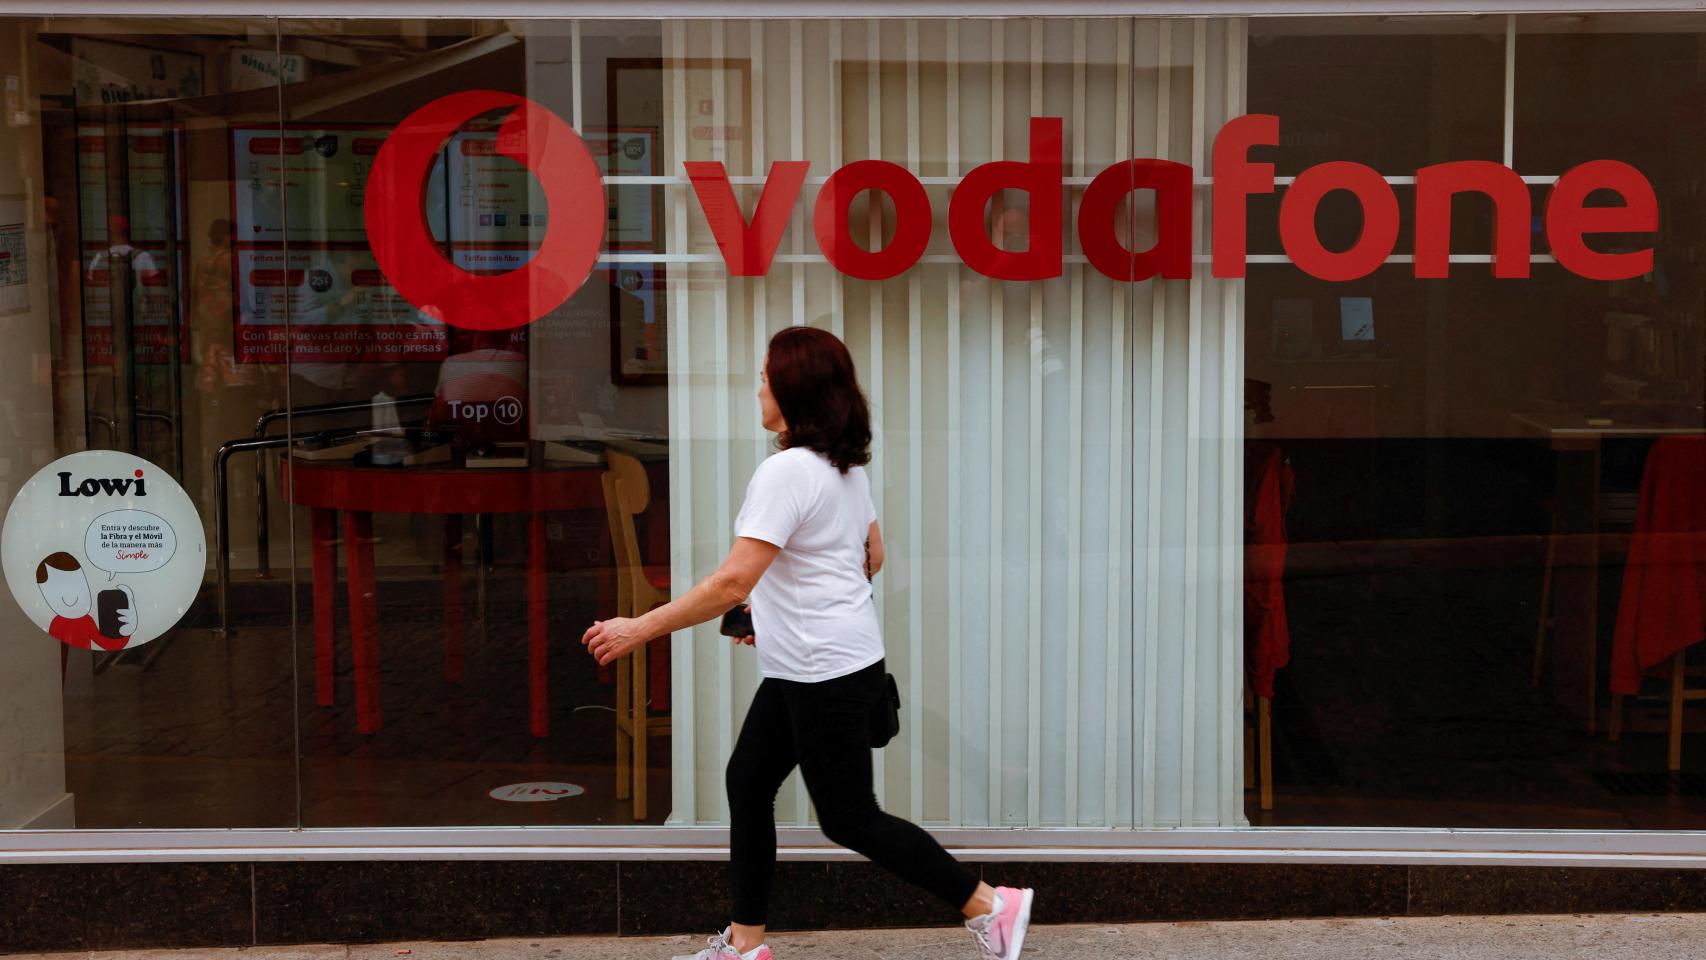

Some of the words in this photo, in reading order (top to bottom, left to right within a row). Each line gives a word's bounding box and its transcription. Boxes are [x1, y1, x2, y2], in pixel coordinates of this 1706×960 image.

[683, 114, 1659, 282] vodafone
[242, 330, 266, 341] Con
[376, 331, 403, 341] todo
[322, 343, 352, 354] claro
[385, 344, 442, 355] sorpresas
[448, 400, 489, 424] Top
[498, 403, 519, 418] 10
[57, 469, 147, 497] Lowi
[100, 532, 108, 540] la
[109, 532, 128, 540] Fibra
[135, 532, 142, 540] el
[143, 532, 163, 540] Móvil
[116, 550, 149, 560] Simple
